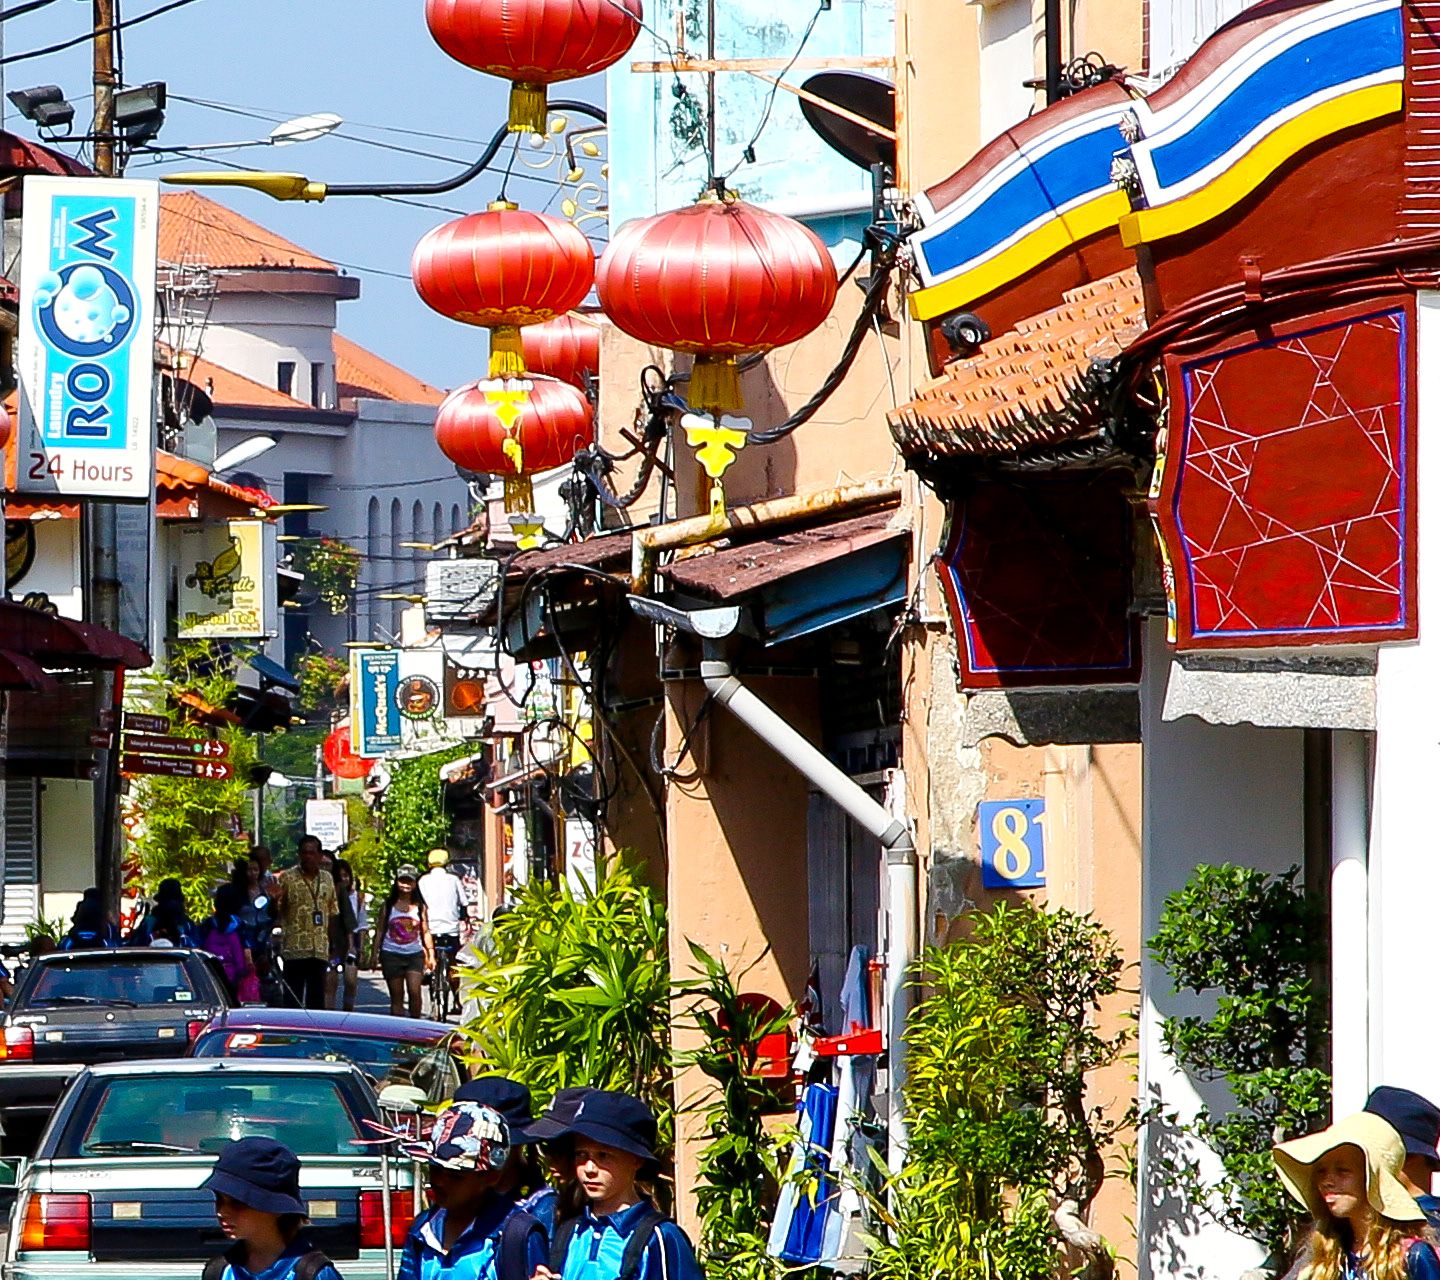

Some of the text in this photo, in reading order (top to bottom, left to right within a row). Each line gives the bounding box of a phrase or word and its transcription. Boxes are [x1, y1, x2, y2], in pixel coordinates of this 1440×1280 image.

[37, 207, 134, 438] ROOM
[46, 371, 67, 440] Laundry
[28, 452, 134, 483] 24 Hours
[232, 610, 256, 625] Tea
